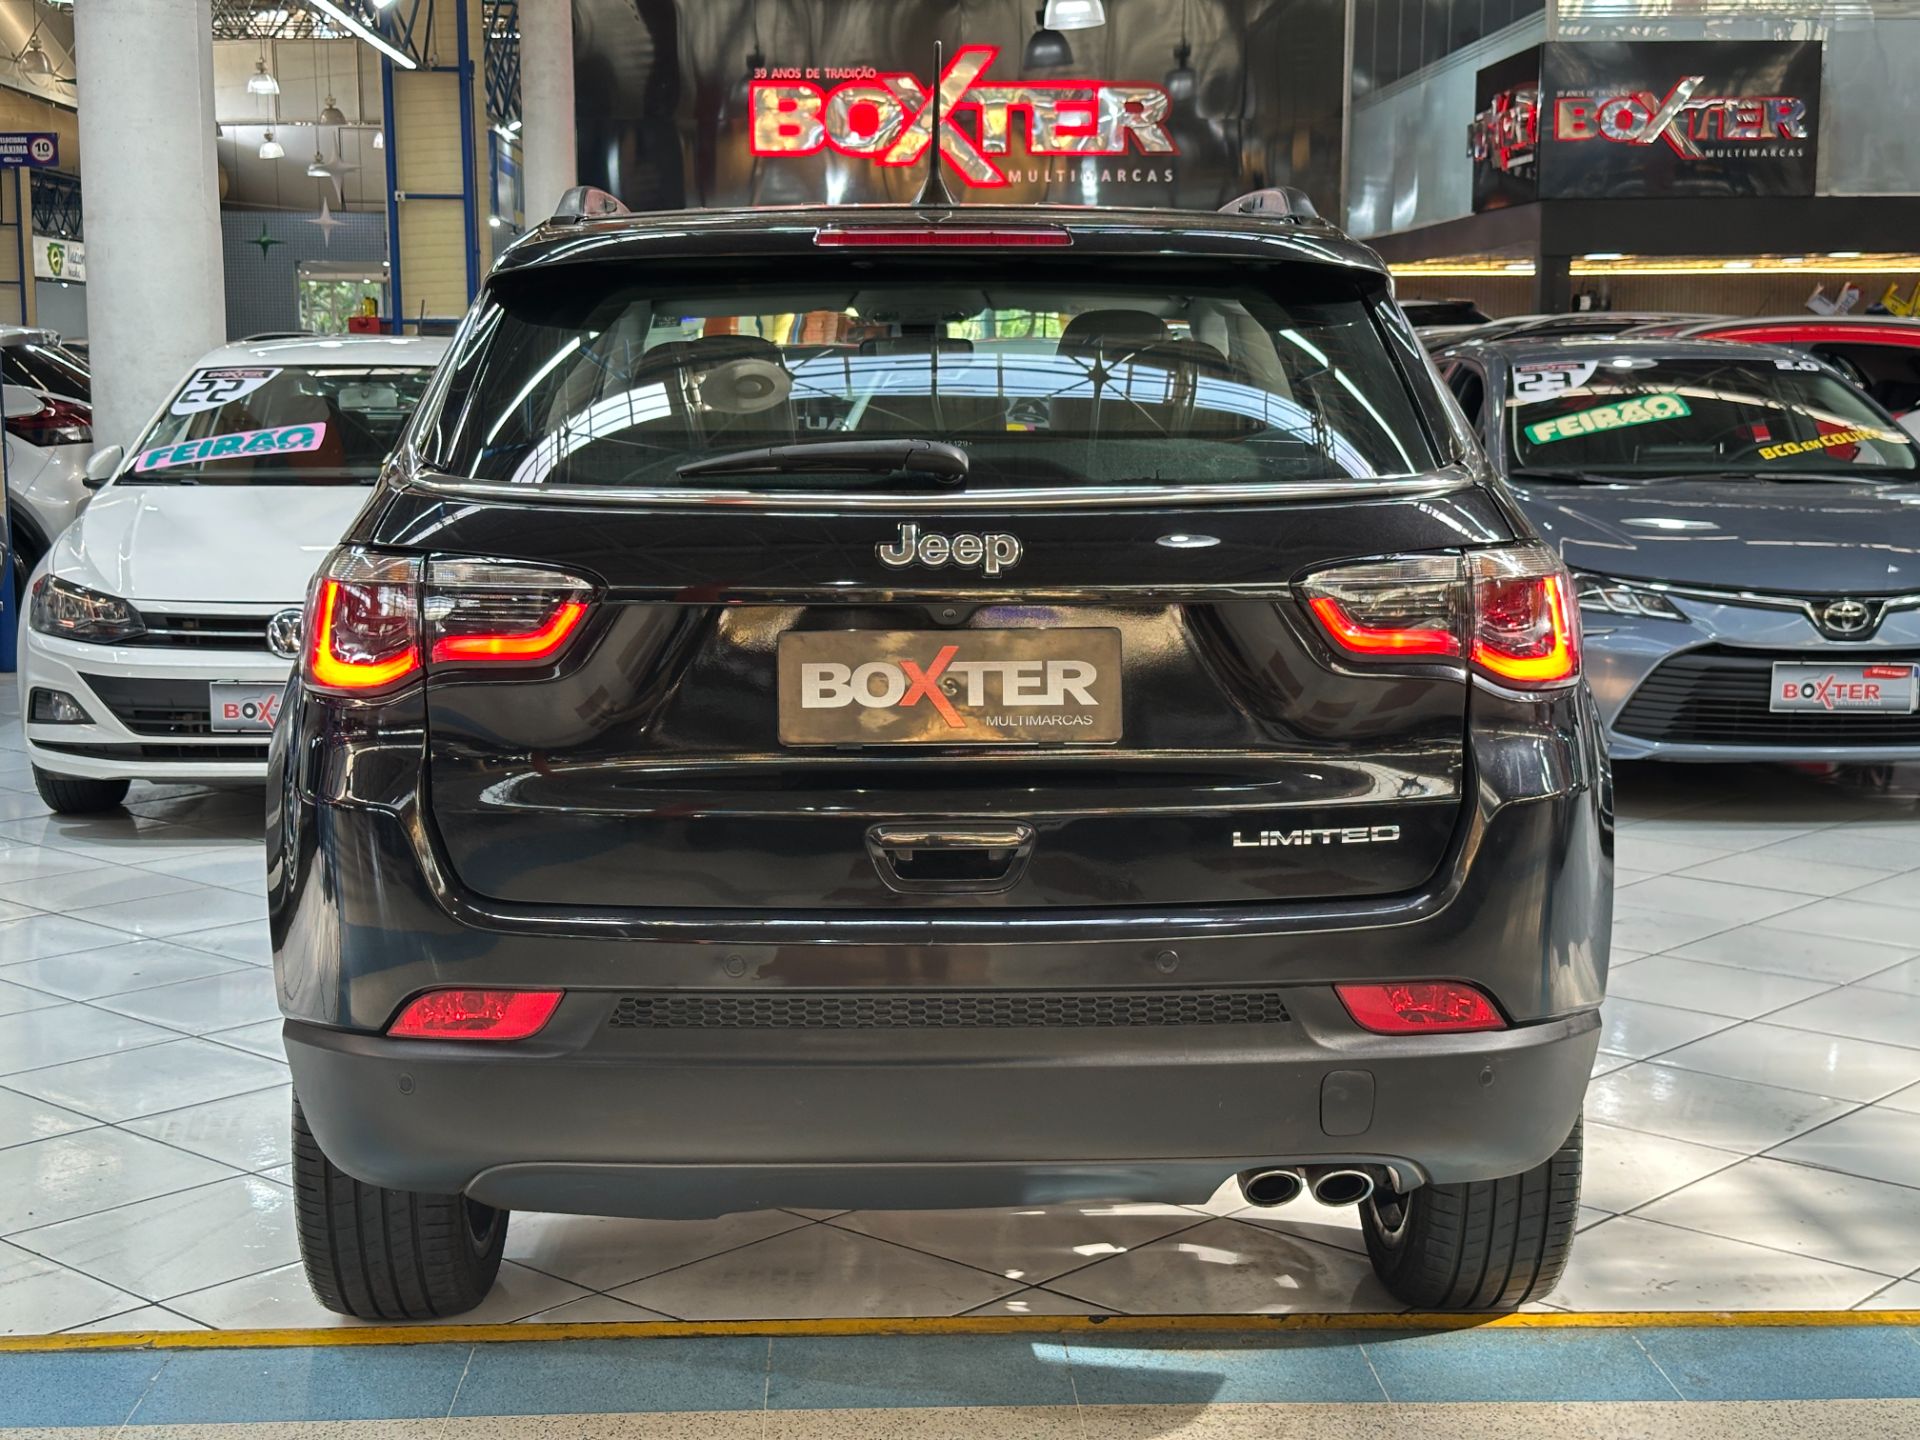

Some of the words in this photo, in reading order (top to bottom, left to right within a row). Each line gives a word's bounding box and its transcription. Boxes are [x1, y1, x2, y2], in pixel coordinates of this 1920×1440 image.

[754, 68, 767, 79] 39
[771, 68, 802, 79] ANOS
[806, 68, 821, 79] DE
[824, 65, 877, 80] TRADIÇÃO
[749, 45, 1181, 188] BOXTER
[1554, 76, 1808, 160] BOXTER
[35, 142, 50, 153] 10
[1705, 148, 1803, 158] MULTIMARCAS
[179, 379, 245, 403] 22
[1518, 372, 1572, 391] 23
[1533, 396, 1685, 442] FEIRÃO
[144, 426, 315, 468] FEIRÃO
[877, 521, 1023, 577] Jeep
[801, 645, 1099, 728] BOXTER
[1782, 674, 1882, 710] BOXTER
[985, 714, 1094, 727] MULTIMARCAS
[1232, 825, 1401, 847] LIMITED
